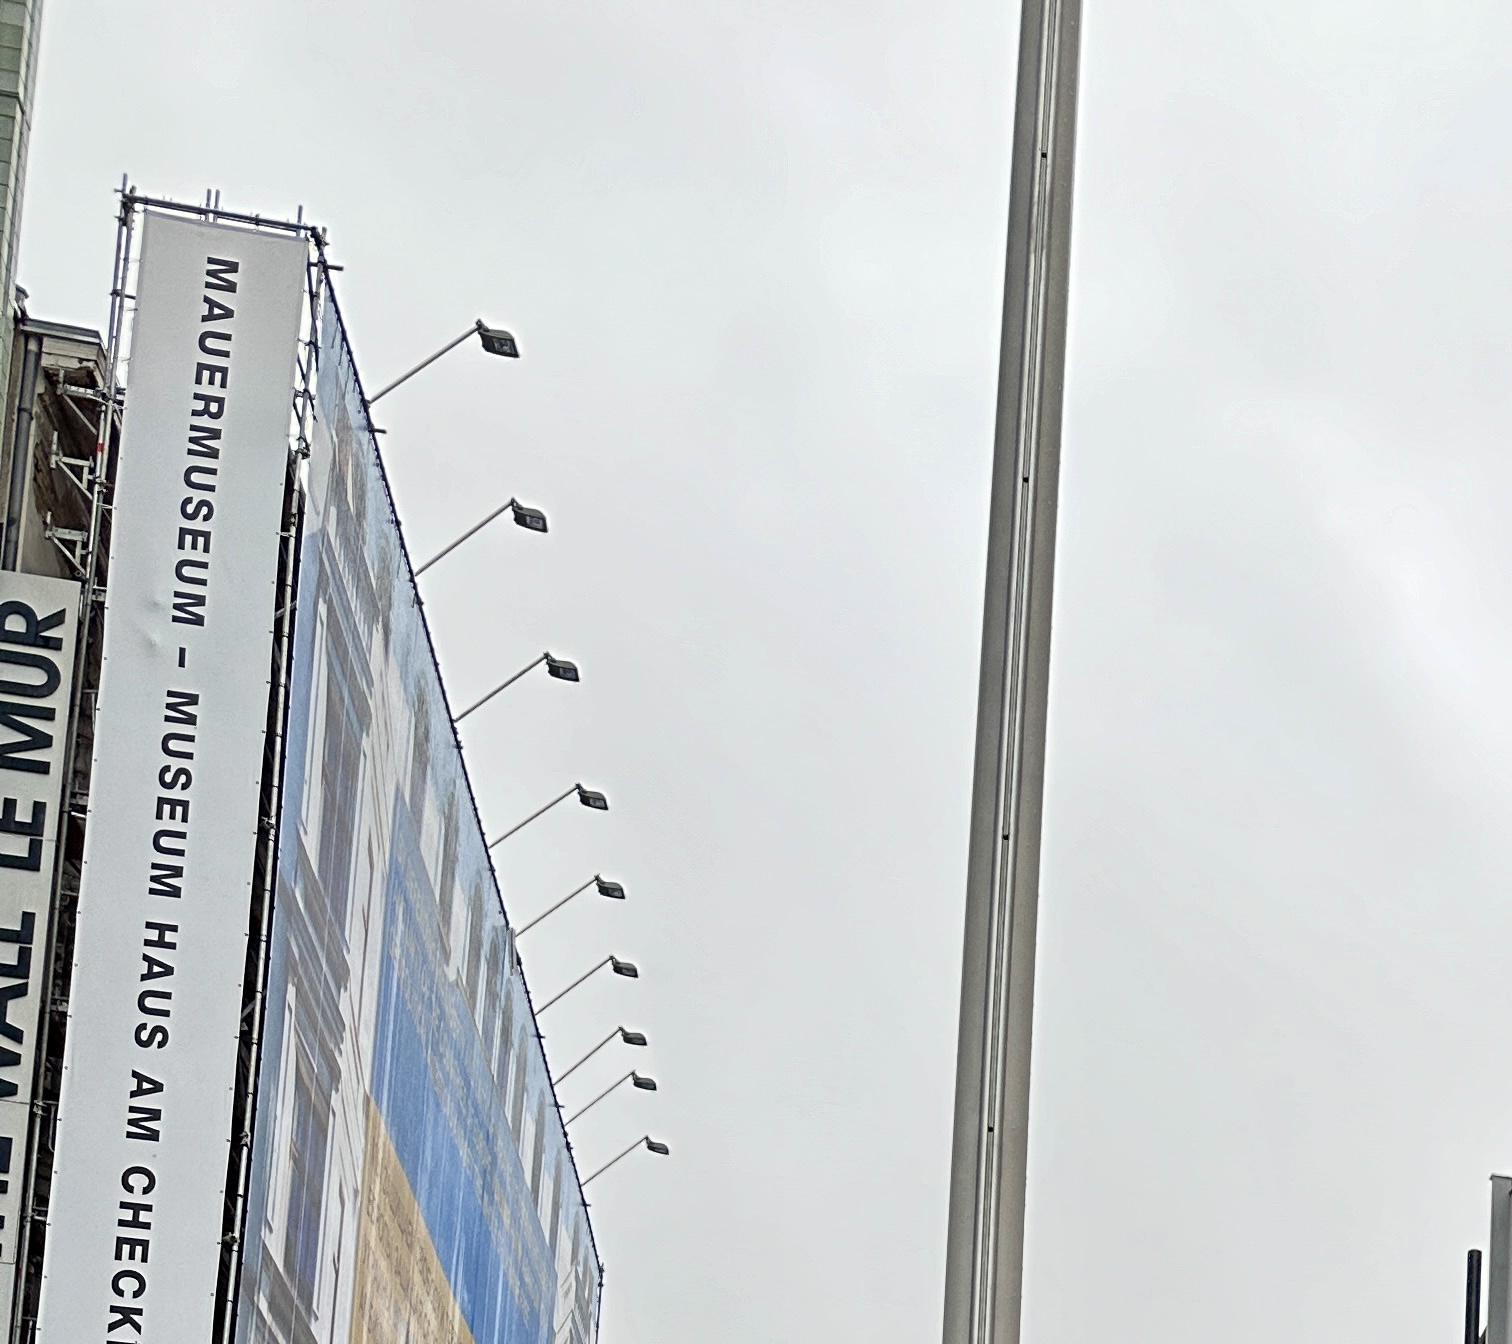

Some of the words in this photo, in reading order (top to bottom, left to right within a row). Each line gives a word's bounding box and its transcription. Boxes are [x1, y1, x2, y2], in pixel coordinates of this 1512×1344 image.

[171, 255, 239, 627] MAUERMUSEUM
[0, 600, 66, 776] MUR
[147, 689, 199, 899] MUSEUM
[134, 921, 178, 1049] HAUS
[126, 1070, 165, 1142] AM
